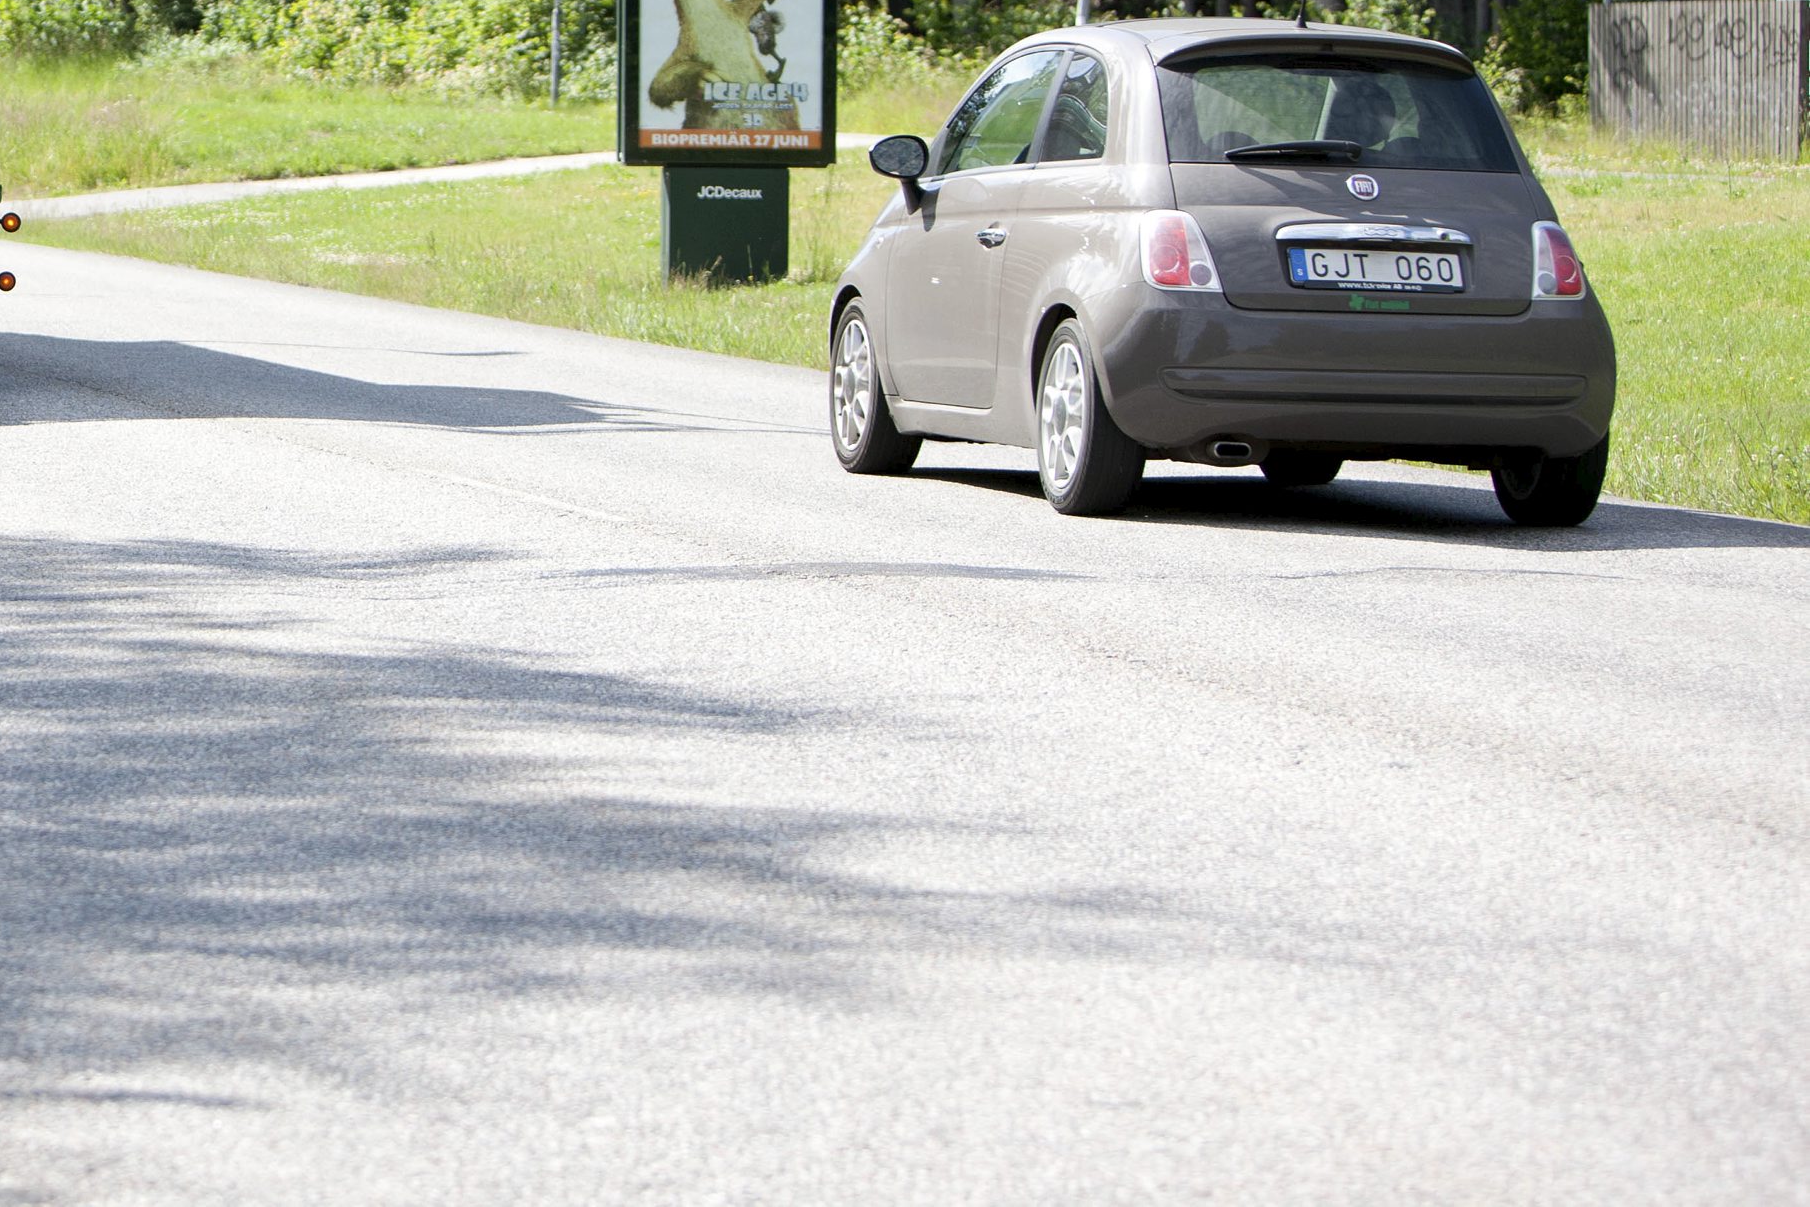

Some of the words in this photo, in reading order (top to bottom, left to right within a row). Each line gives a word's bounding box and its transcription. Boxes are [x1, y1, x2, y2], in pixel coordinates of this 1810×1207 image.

[703, 82, 741, 102] ICE
[746, 82, 790, 102] AGE
[743, 112, 764, 127] 3D
[651, 130, 751, 146] BIOPREMIÄR
[754, 134, 770, 146] 27
[772, 134, 809, 150] JUNI
[697, 185, 762, 200] JCDecaux
[1354, 180, 1373, 194] FIAT
[1296, 268, 1304, 276] S
[1311, 252, 1369, 279] GJT
[1395, 255, 1454, 283] 060
